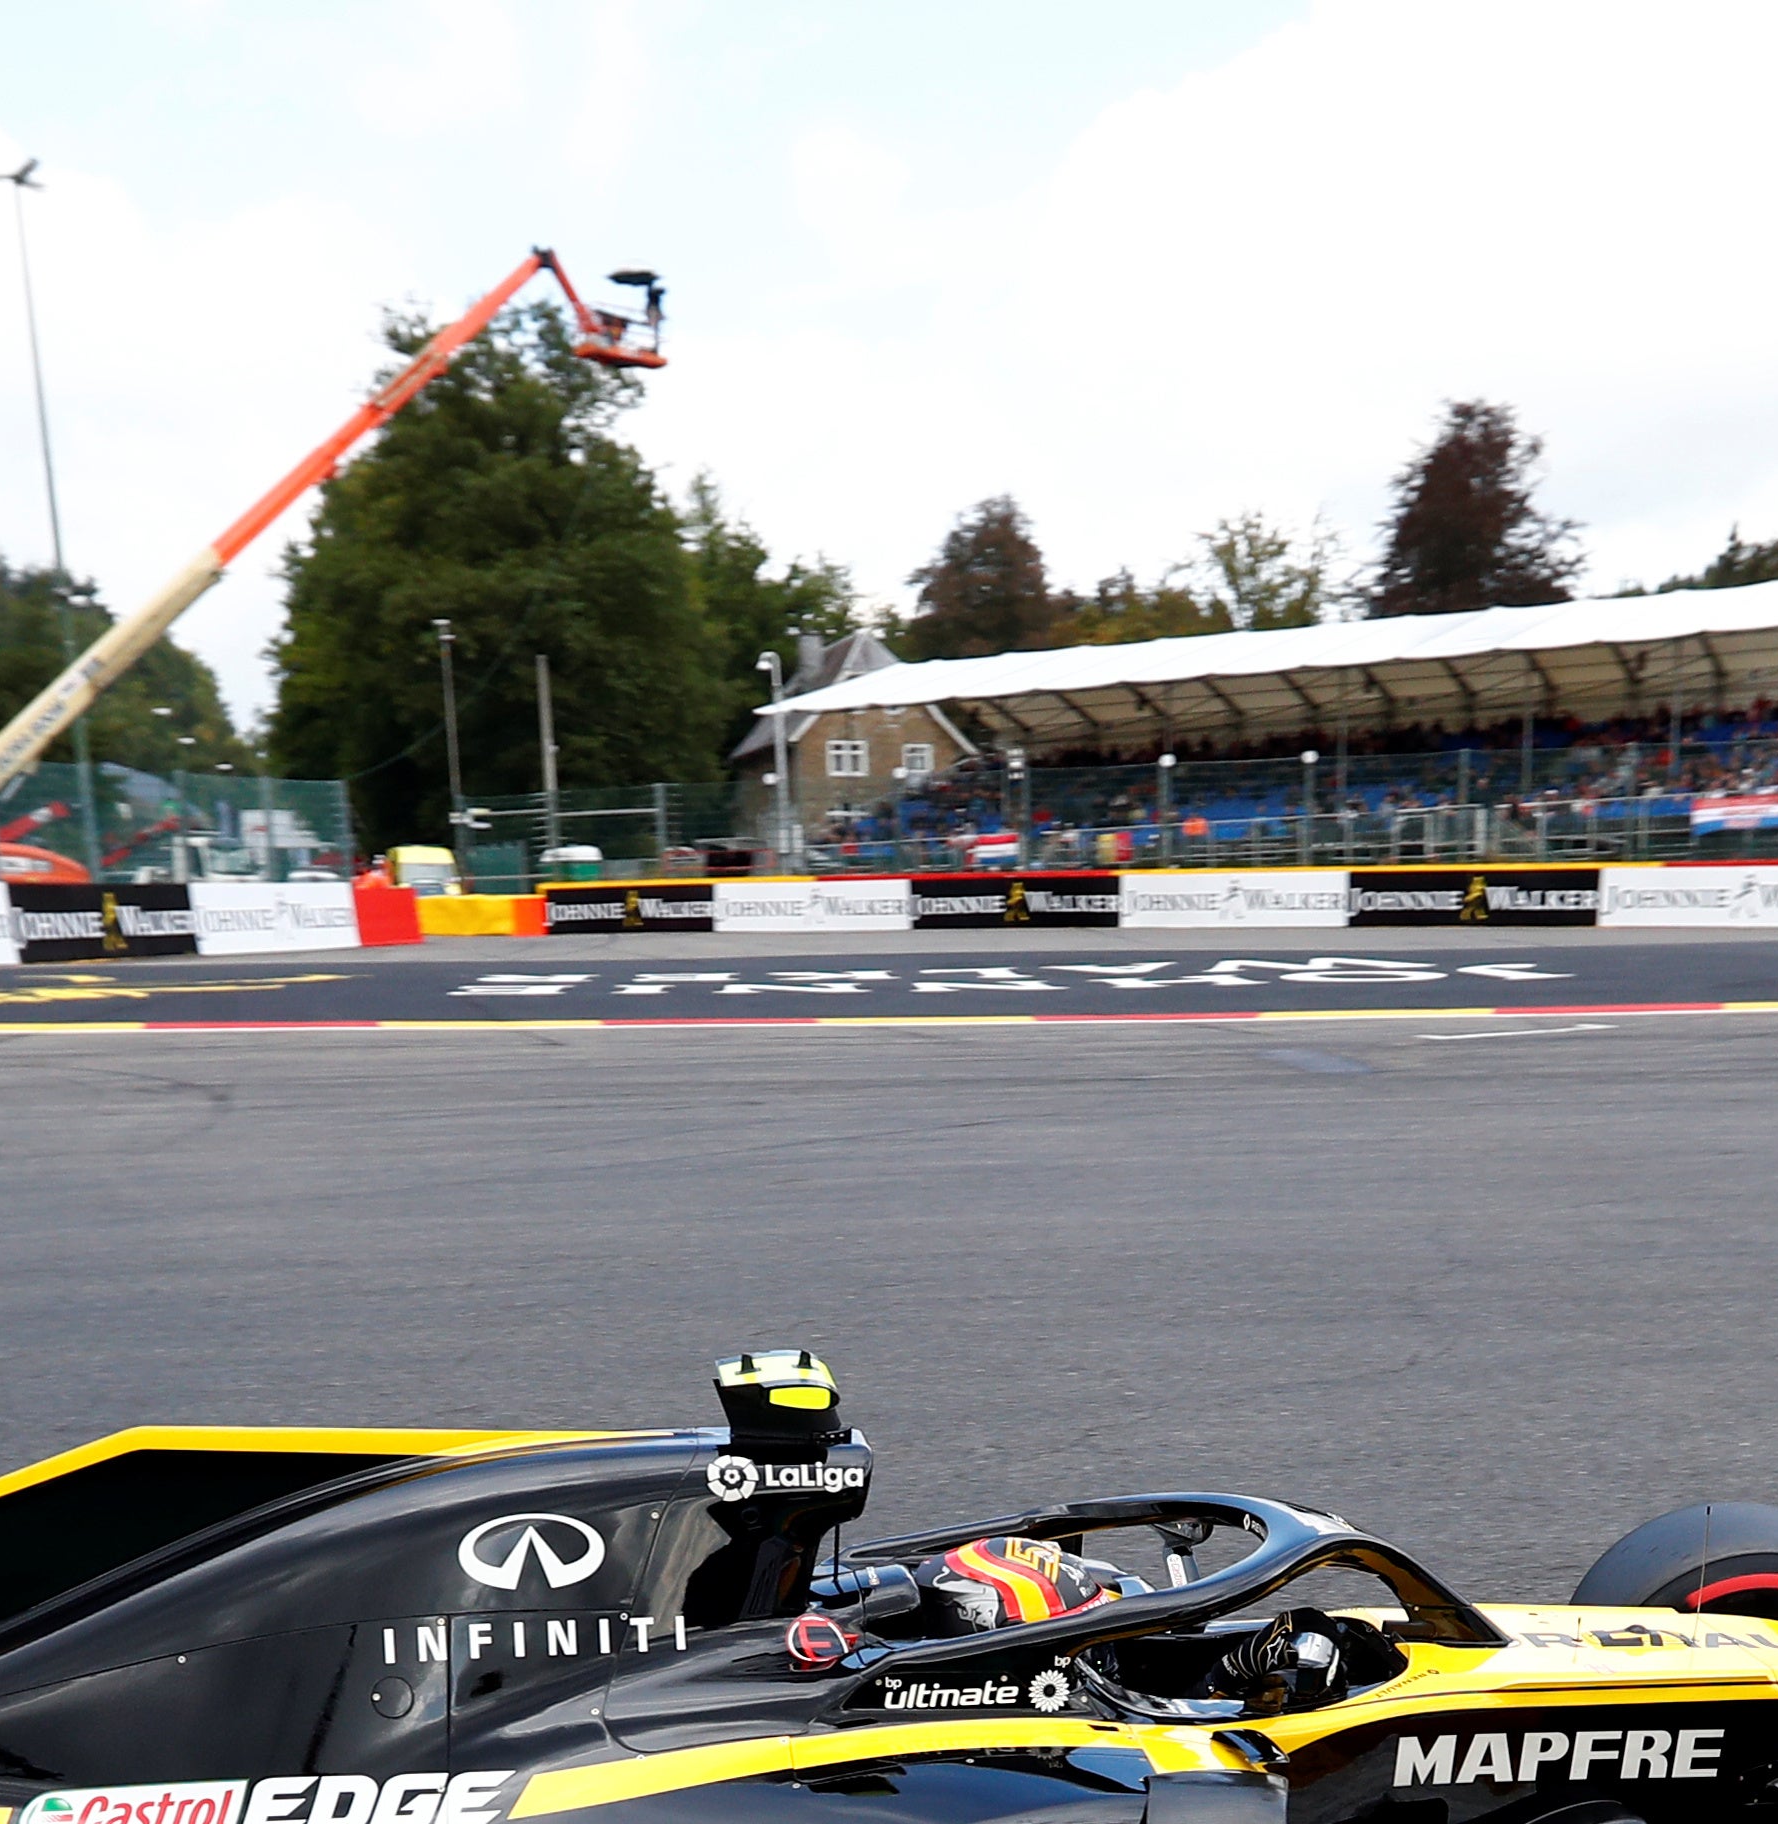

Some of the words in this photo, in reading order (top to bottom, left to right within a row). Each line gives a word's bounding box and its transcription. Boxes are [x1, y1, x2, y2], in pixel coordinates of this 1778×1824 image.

[1025, 892, 1120, 914] WALKER
[1241, 887, 1348, 912] WALKER
[1347, 888, 1463, 919] JOHNNIE
[1484, 885, 1600, 912] WALKER
[764, 1463, 864, 1491] LaLiga
[383, 1615, 688, 1664] INFINITI
[1054, 1656, 1071, 1668] bp
[884, 1681, 1019, 1709] ultimate
[885, 1677, 902, 1689] bp
[1392, 1729, 1724, 1788] MAPFRE
